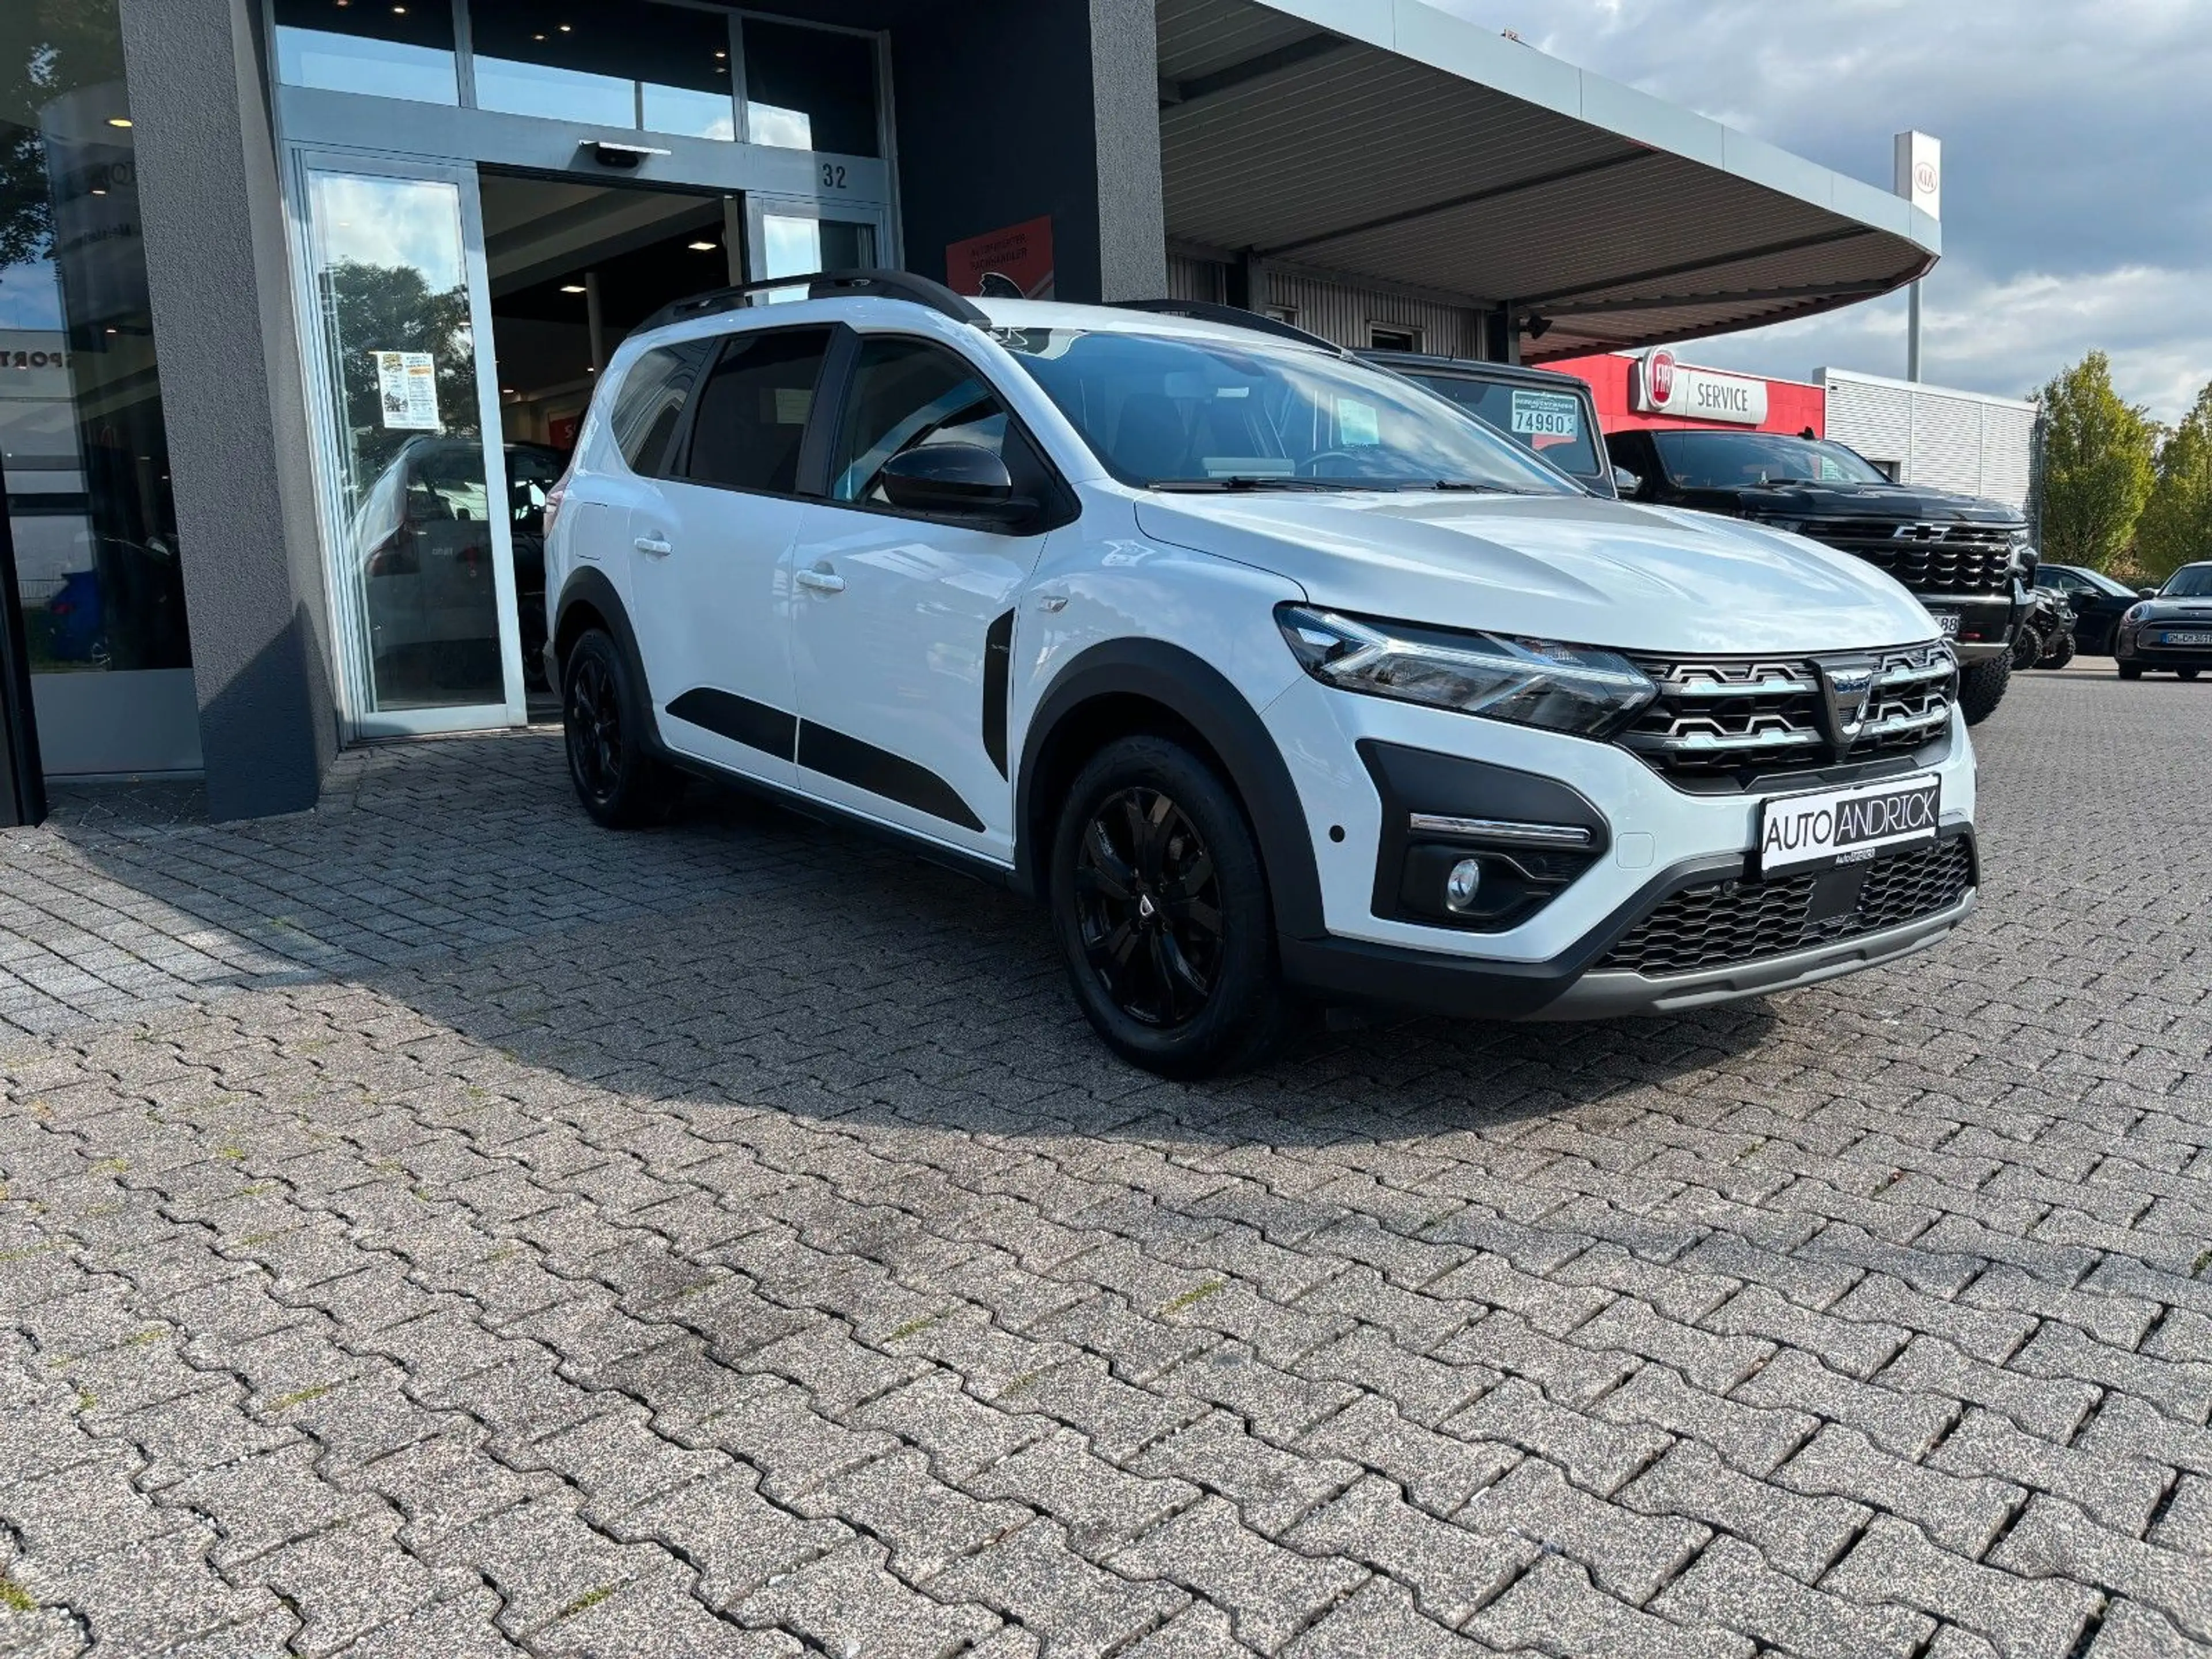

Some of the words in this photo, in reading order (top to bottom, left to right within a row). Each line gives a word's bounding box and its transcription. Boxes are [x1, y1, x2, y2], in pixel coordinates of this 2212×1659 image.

[823, 163, 847, 188] 32
[1918, 168, 1934, 188] KIA
[1698, 382, 1748, 412] SERVICE
[1516, 412, 1563, 433] 74990
[1763, 810, 1832, 854] AUTO
[1836, 790, 1936, 842] ANDRICK
